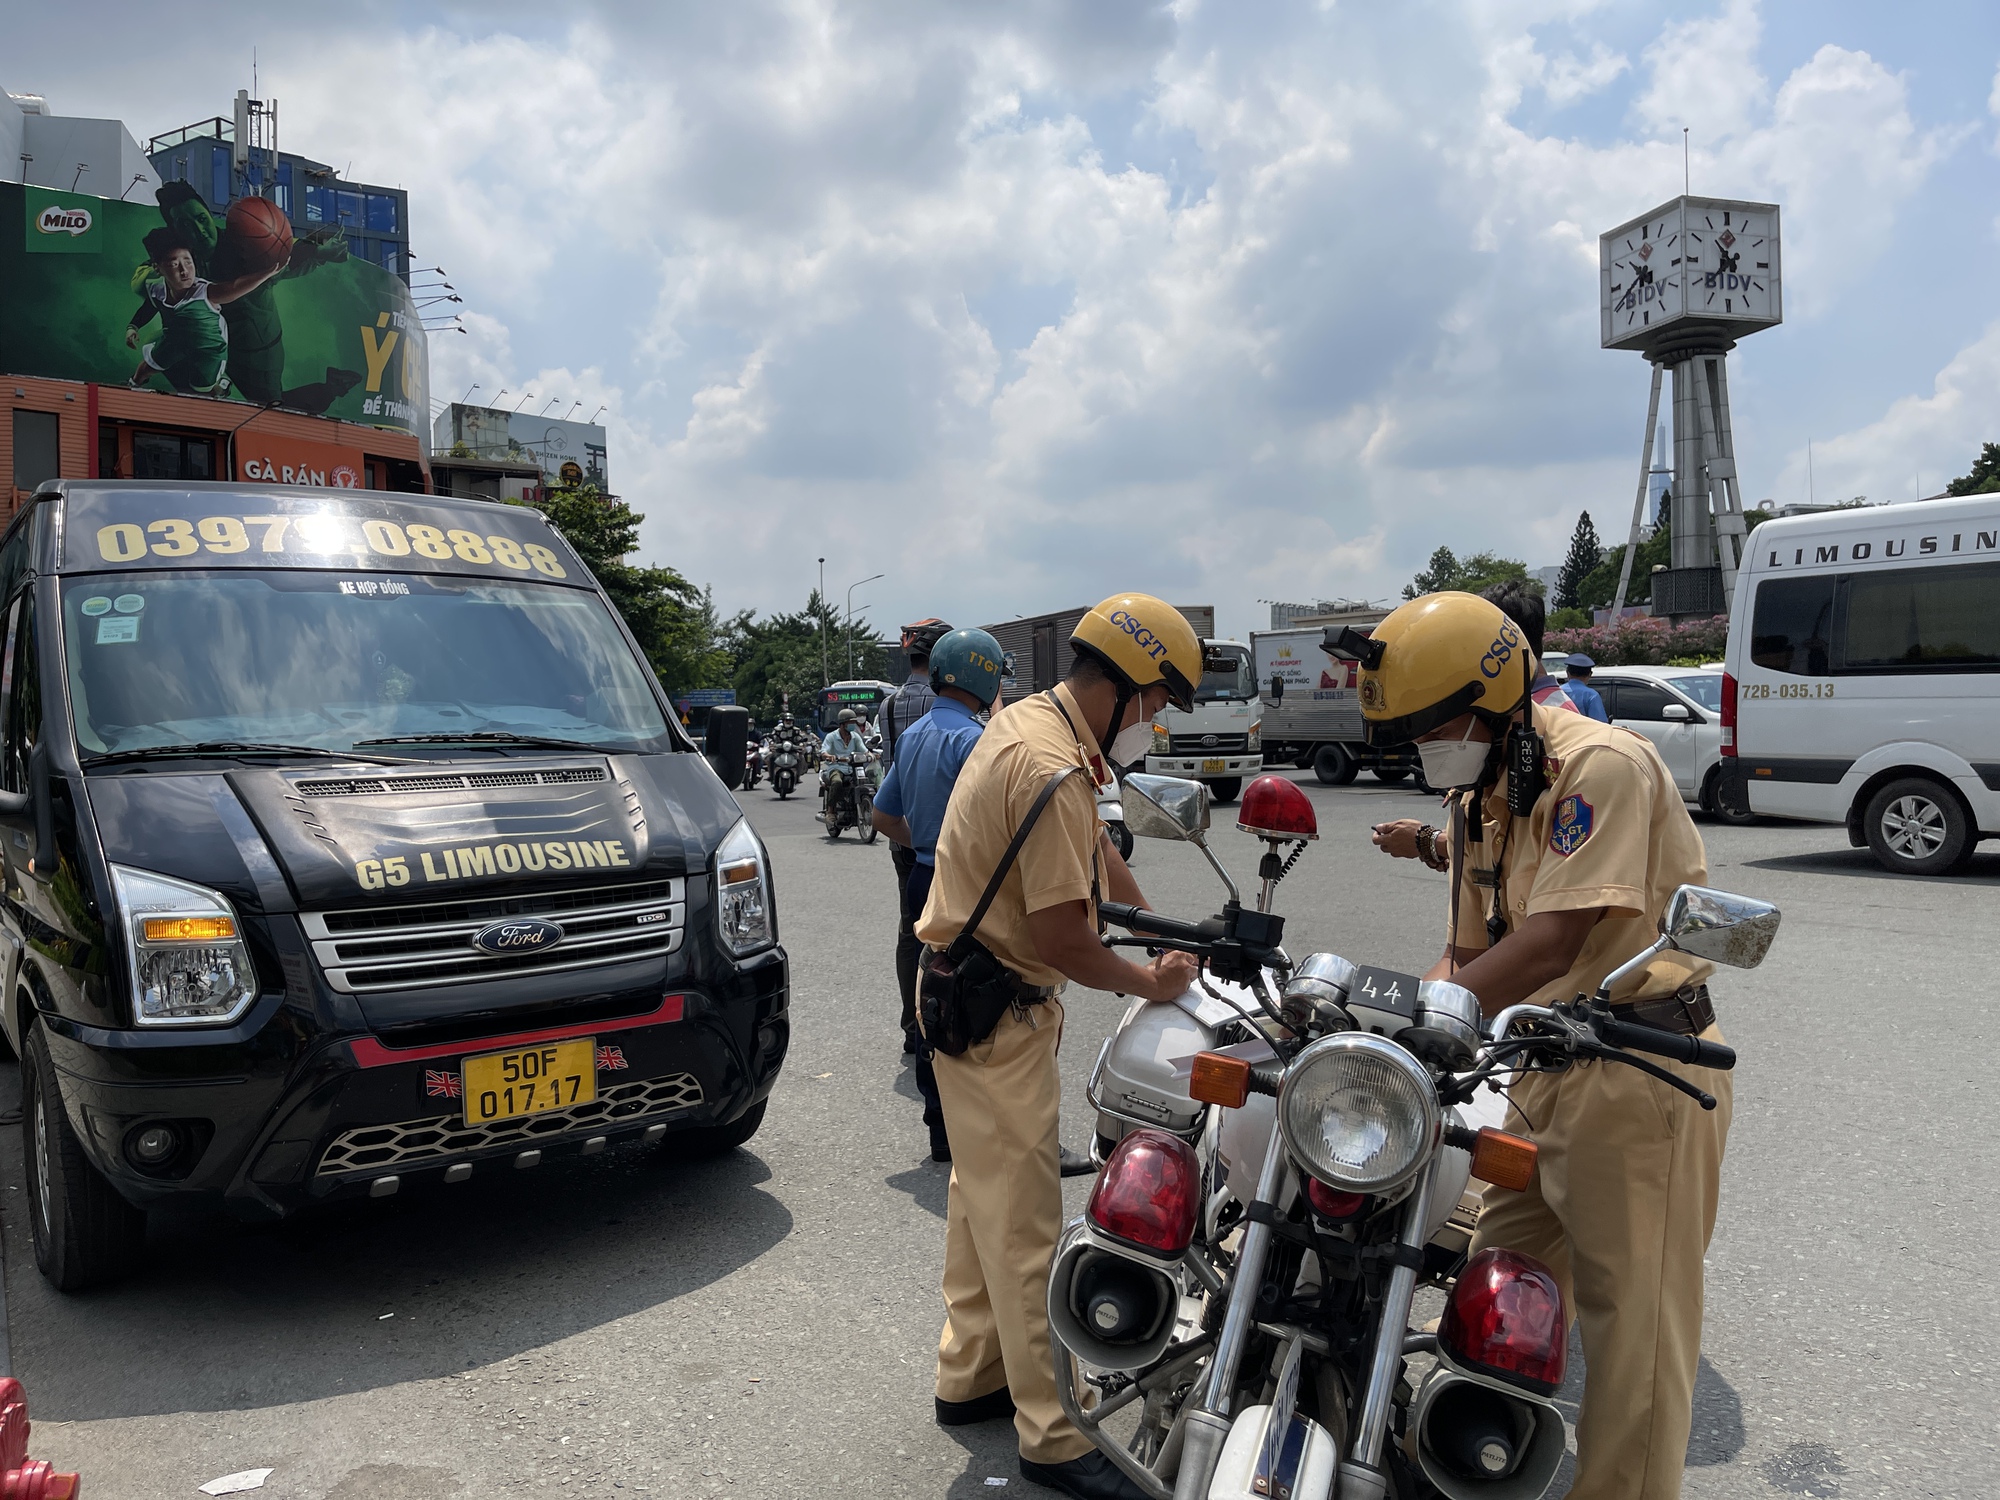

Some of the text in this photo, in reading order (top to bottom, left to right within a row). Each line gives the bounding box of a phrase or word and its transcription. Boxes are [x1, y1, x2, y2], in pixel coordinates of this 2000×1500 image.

[44, 214, 87, 228] MILO
[1625, 277, 1667, 310] BIDV
[1704, 272, 1751, 291] BIDV
[360, 311, 399, 392] Ý
[536, 450, 578, 462] SHZEN HOME
[244, 457, 326, 487] GÀ RÁN
[96, 516, 568, 579] 0397.08888
[1768, 530, 1998, 568] LIMOUSIN
[339, 581, 356, 595] XE
[355, 580, 378, 597] HỢP
[1110, 610, 1168, 660] CSGT
[969, 651, 999, 676] TTGT
[1741, 683, 1834, 699] 72B-035.13
[1568, 824, 1583, 835] GT
[355, 840, 631, 891] G5 LIMOUSINE
[497, 924, 546, 947] Ford
[502, 1048, 558, 1082] 50F
[480, 1075, 581, 1118] 017.17
[1481, 1451, 1506, 1464] PATLITE
